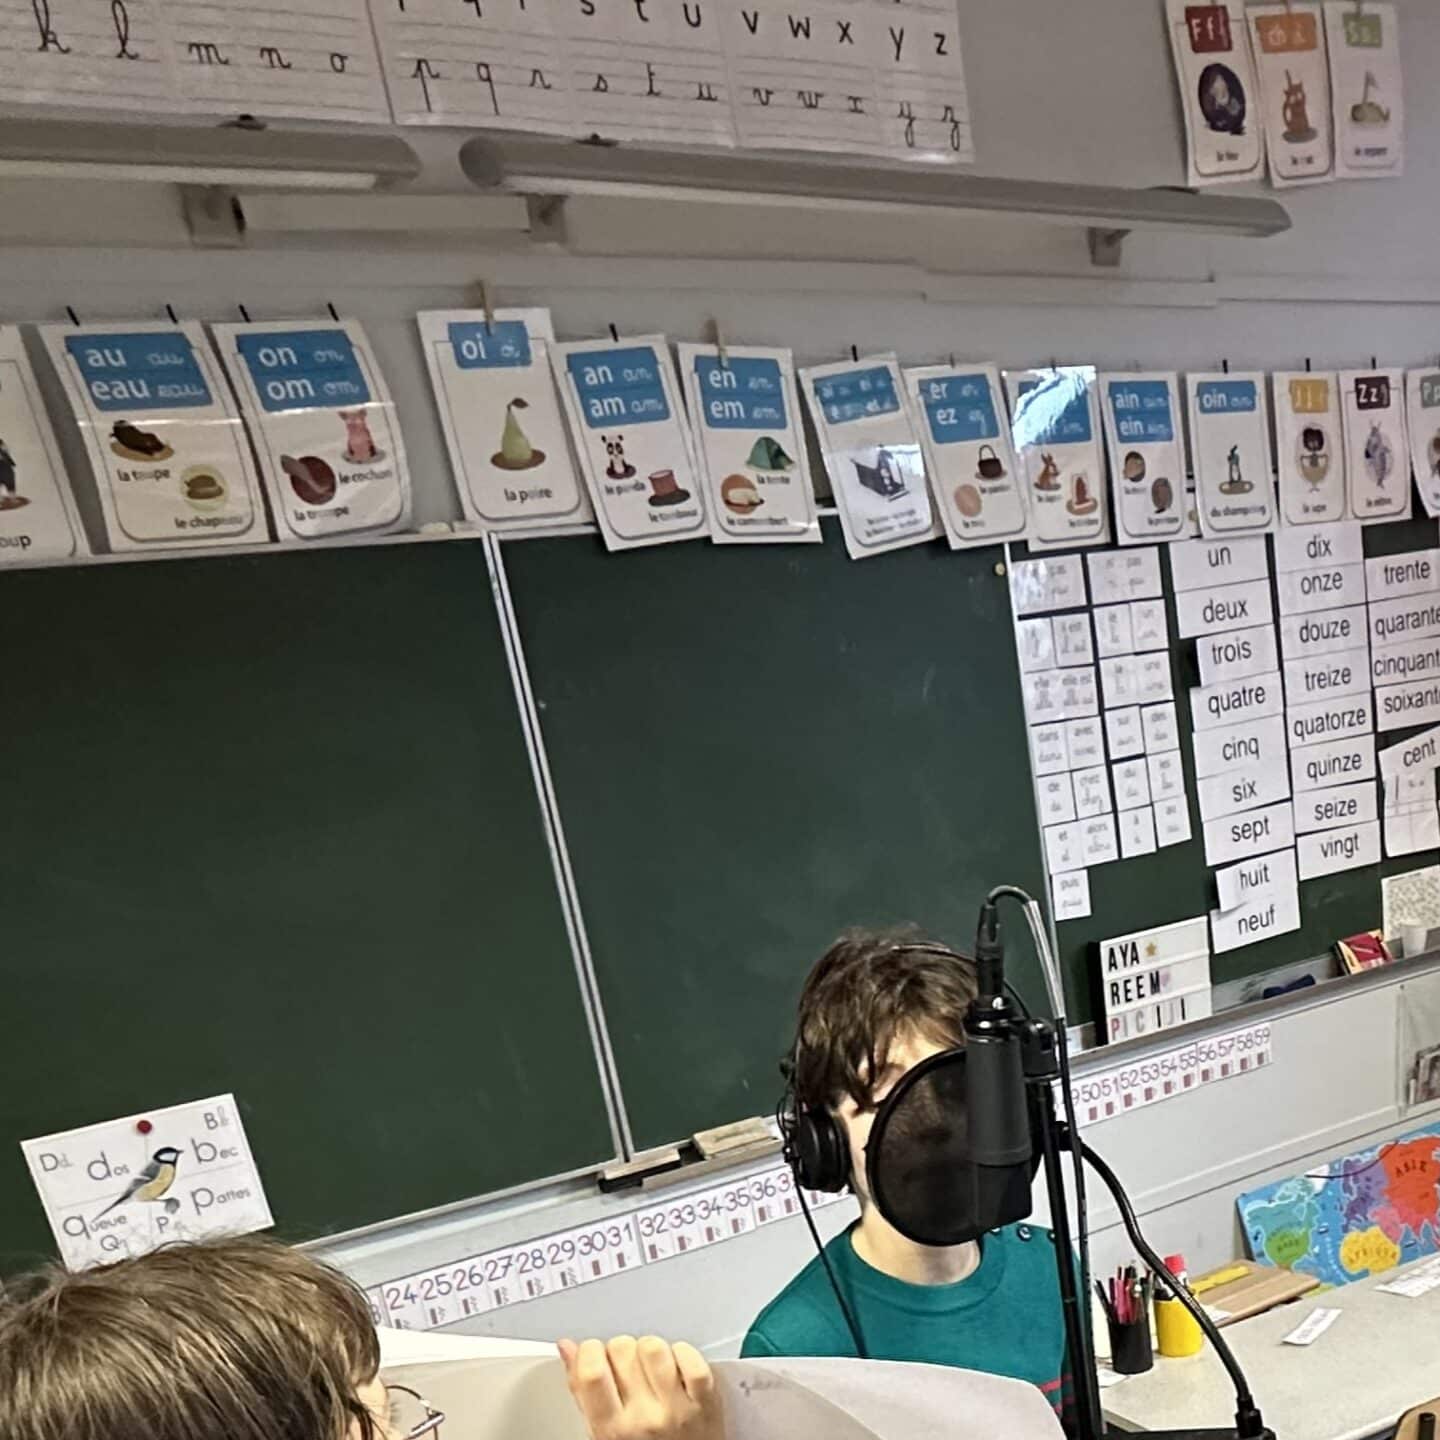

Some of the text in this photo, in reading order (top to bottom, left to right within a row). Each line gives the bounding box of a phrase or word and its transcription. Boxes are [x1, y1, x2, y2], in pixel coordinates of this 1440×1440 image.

[742, 10, 759, 36] v
[789, 15, 810, 41] w
[837, 21, 854, 45] x
[890, 27, 905, 61] y
[934, 32, 947, 55] z
[188, 42, 230, 66] m
[260, 46, 292, 70] n
[330, 52, 349, 74] o
[411, 58, 440, 113] p
[476, 62, 499, 116] q
[86, 347, 127, 368] au
[259, 346, 297, 367] on
[461, 334, 486, 360] oi
[90, 378, 151, 401] eau
[266, 378, 315, 399] om
[584, 364, 613, 386] an
[709, 370, 737, 389] en
[929, 382, 948, 400] er
[1115, 390, 1140, 409] ain
[1202, 389, 1228, 408] oin
[590, 395, 626, 418] am
[709, 400, 745, 419] em
[935, 408, 958, 425] ez
[1119, 418, 1145, 436] ein
[1207, 535, 1333, 567] un dix
[1301, 560, 1431, 595] onze trente
[1203, 599, 1249, 623] deux
[1300, 617, 1351, 643] douze
[1212, 639, 1252, 664] trois
[1305, 665, 1352, 692] treize
[1208, 685, 1266, 717] quatre
[1294, 706, 1366, 738] quatorze
[1222, 736, 1437, 780] cinq quinze cent
[1232, 779, 1358, 821] six seize
[1231, 817, 1360, 858] sept vingt
[1239, 863, 1270, 889] huit
[1238, 904, 1276, 935] neuf
[1108, 941, 1140, 972] AYA
[1110, 970, 1160, 1006] REEM
[1083, 1026, 1271, 1101] 50 51 52 53 54 55 56 57 58 59
[87, 1137, 240, 1181] dos bec
[62, 1213, 128, 1240] queue
[386, 1282, 419, 1312] 24
[419, 1273, 453, 1301] 25
[453, 1263, 484, 1292] 26
[484, 1253, 514, 1282] 27
[515, 1248, 547, 1275] 28
[547, 1240, 577, 1265] 29
[578, 1230, 607, 1256] 30
[607, 1222, 634, 1248] 31
[640, 1212, 669, 1239] 32
[668, 1204, 697, 1229] 33
[697, 1194, 725, 1218] 34
[724, 1186, 751, 1212] 35
[750, 1175, 777, 1200] 36
